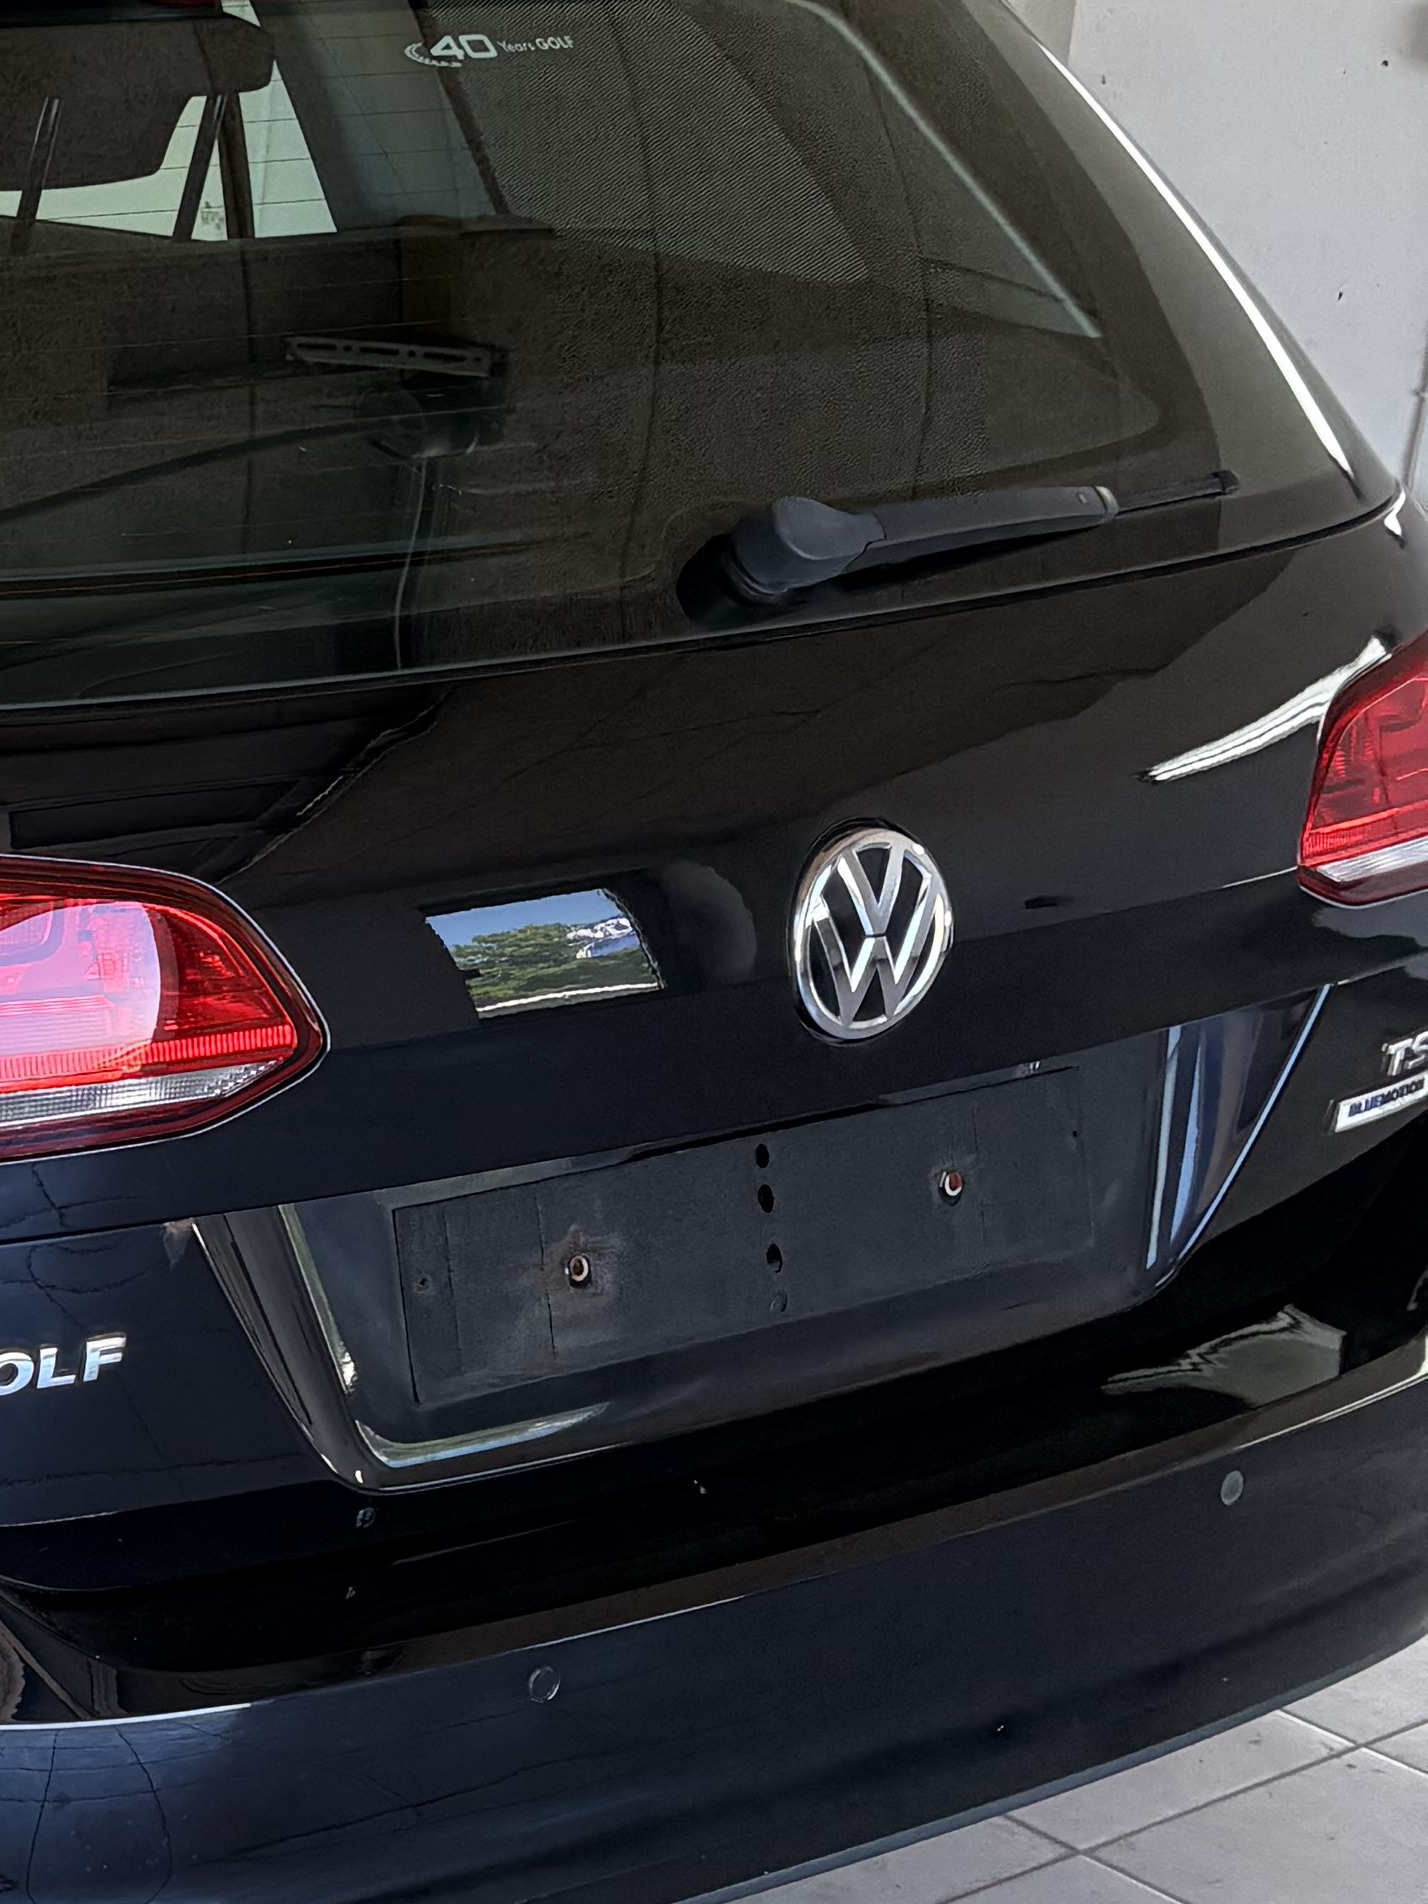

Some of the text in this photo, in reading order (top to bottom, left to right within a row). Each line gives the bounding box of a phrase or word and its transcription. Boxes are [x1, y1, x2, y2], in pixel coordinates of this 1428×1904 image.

[430, 34, 575, 60] 40 Years GOLF
